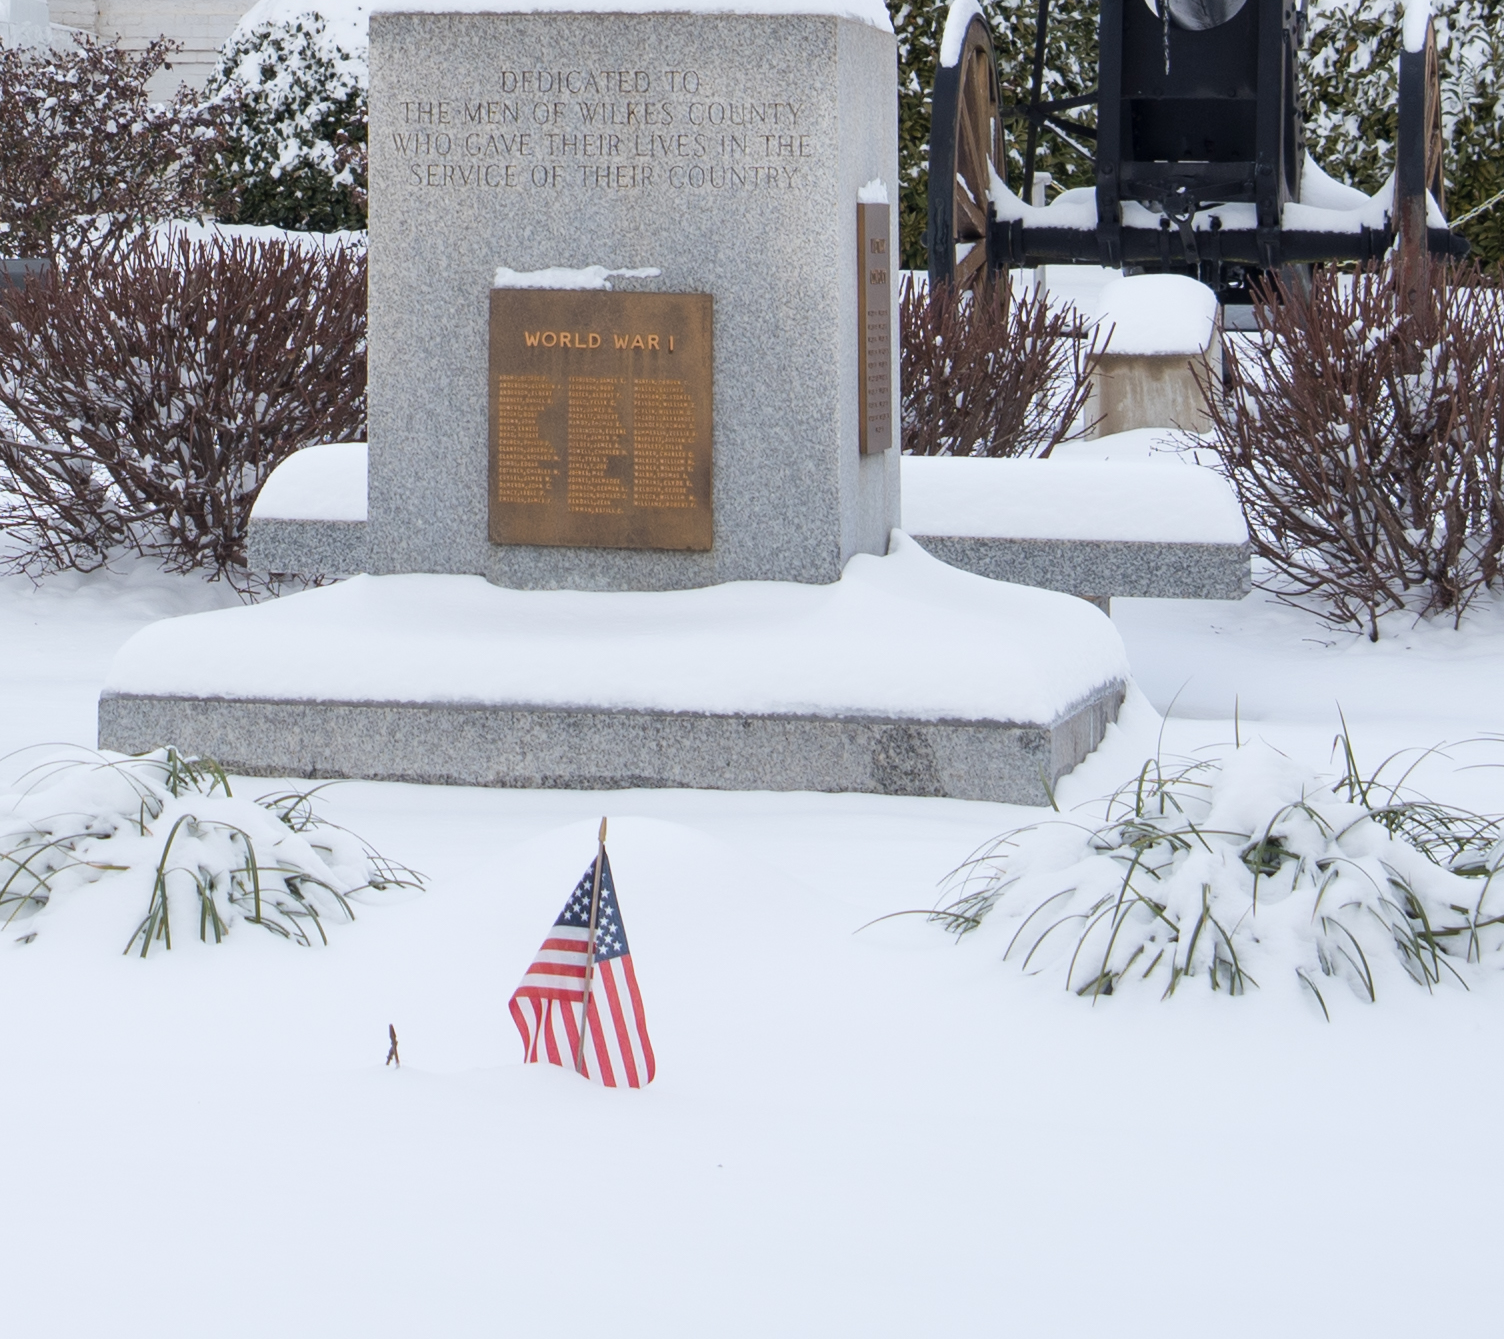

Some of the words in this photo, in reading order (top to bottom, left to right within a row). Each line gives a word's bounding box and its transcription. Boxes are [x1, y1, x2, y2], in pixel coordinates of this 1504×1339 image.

[501, 70, 651, 94] DEDICATED
[665, 70, 700, 94] TO
[400, 101, 452, 125] THE
[463, 101, 520, 125] MEN
[532, 101, 567, 125] OF
[578, 101, 675, 126] WILKES
[688, 101, 804, 126] COUNTY
[392, 132, 452, 157] WHO
[465, 132, 533, 157] GAVE
[544, 133, 622, 157] THEIR
[635, 132, 707, 158] LIVES
[721, 133, 748, 158] IN
[760, 133, 812, 158] THE
[409, 163, 518, 188] SERVICE
[531, 164, 565, 188] OF
[577, 164, 654, 189] THEIR
[668, 164, 799, 190] COUNTRY
[524, 330, 601, 350] WORLD
[613, 333, 660, 351] WAR
[668, 335, 674, 352] I
